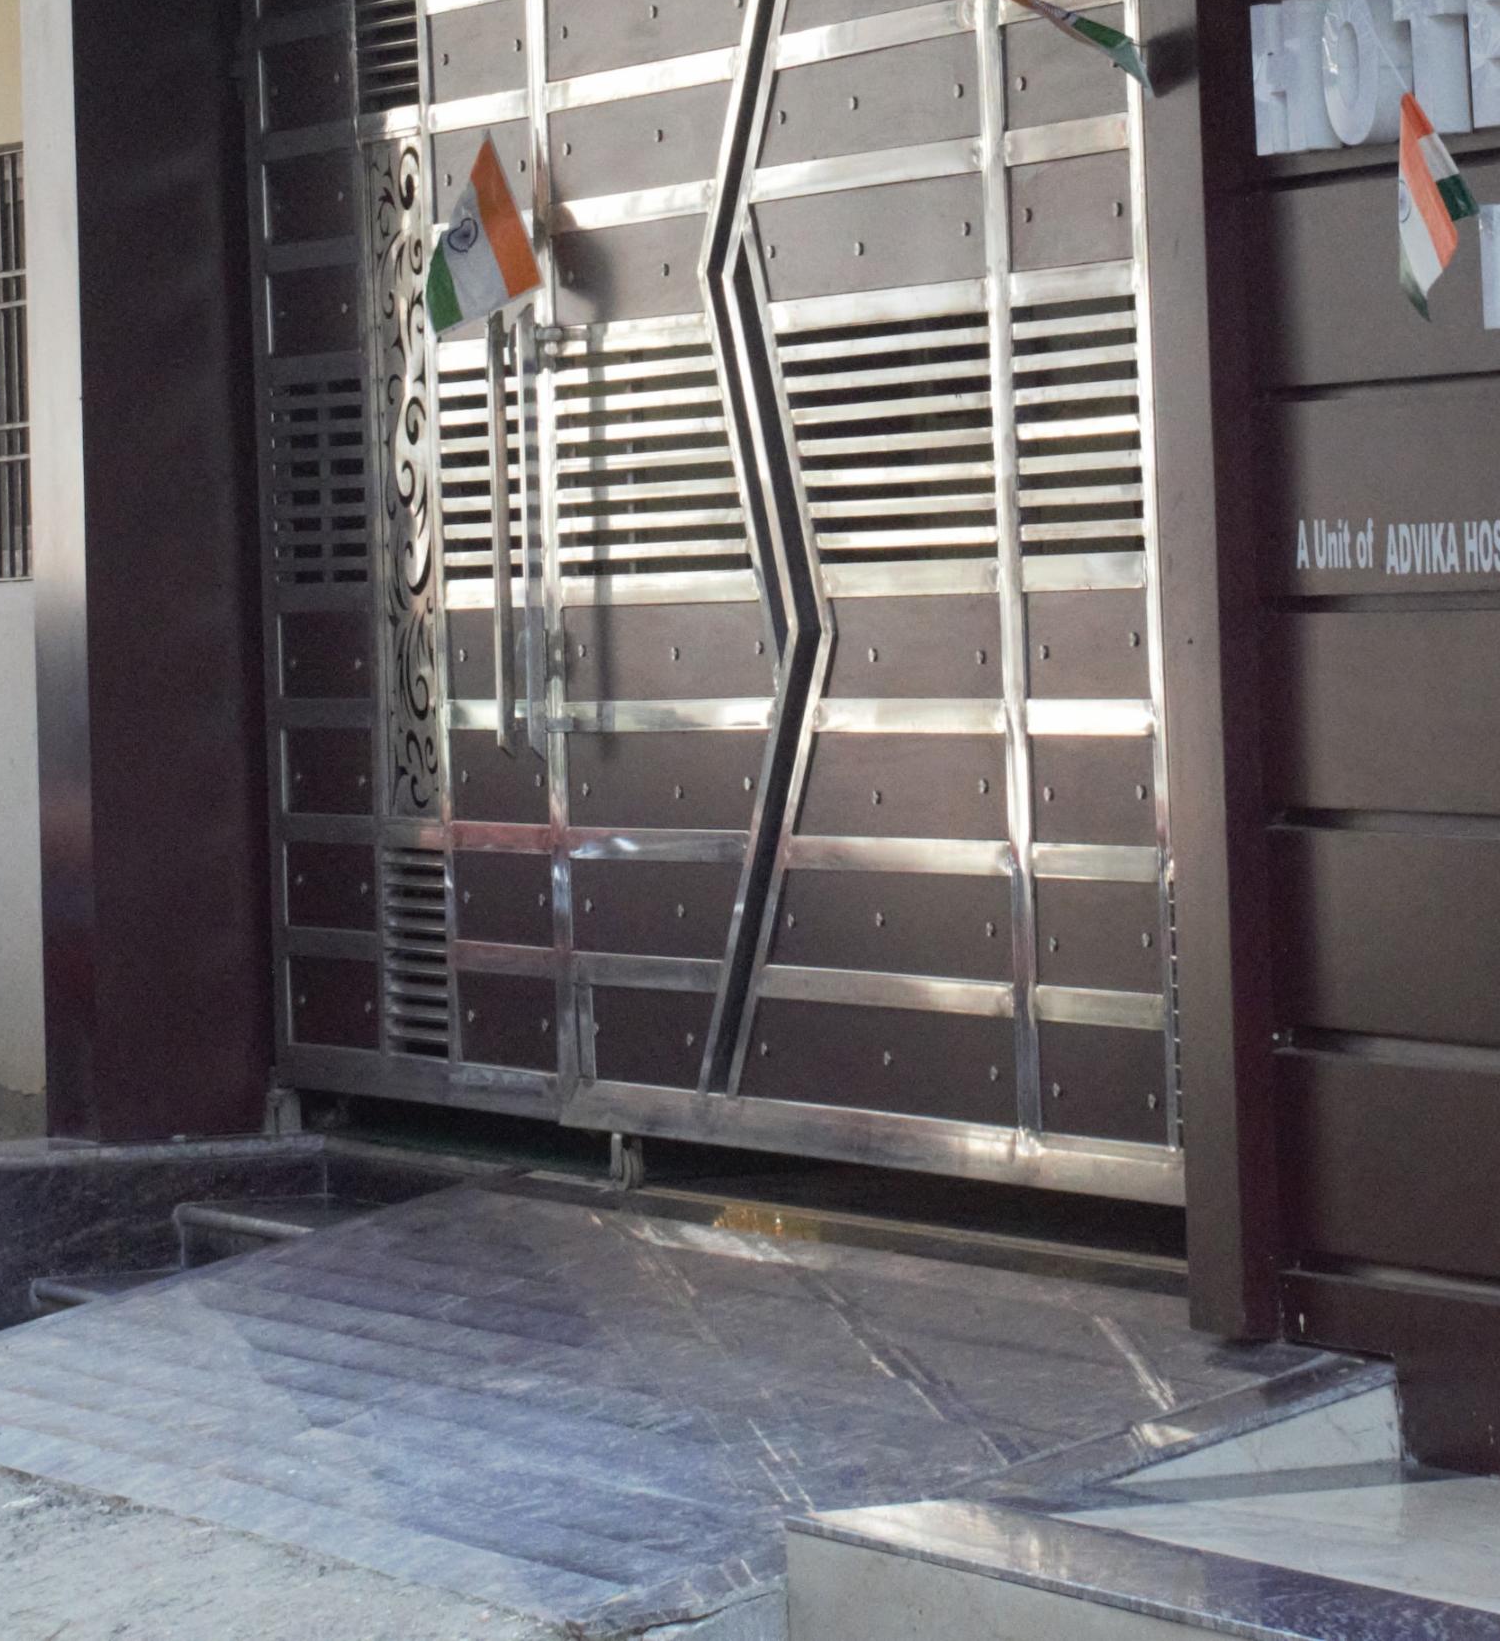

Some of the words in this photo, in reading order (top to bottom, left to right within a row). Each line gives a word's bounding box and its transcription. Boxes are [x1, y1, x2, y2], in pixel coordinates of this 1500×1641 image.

[1297, 519, 1311, 569] A
[1314, 519, 1351, 569] Unit
[1356, 517, 1374, 569] of
[1386, 522, 1460, 575] ADVIKA
